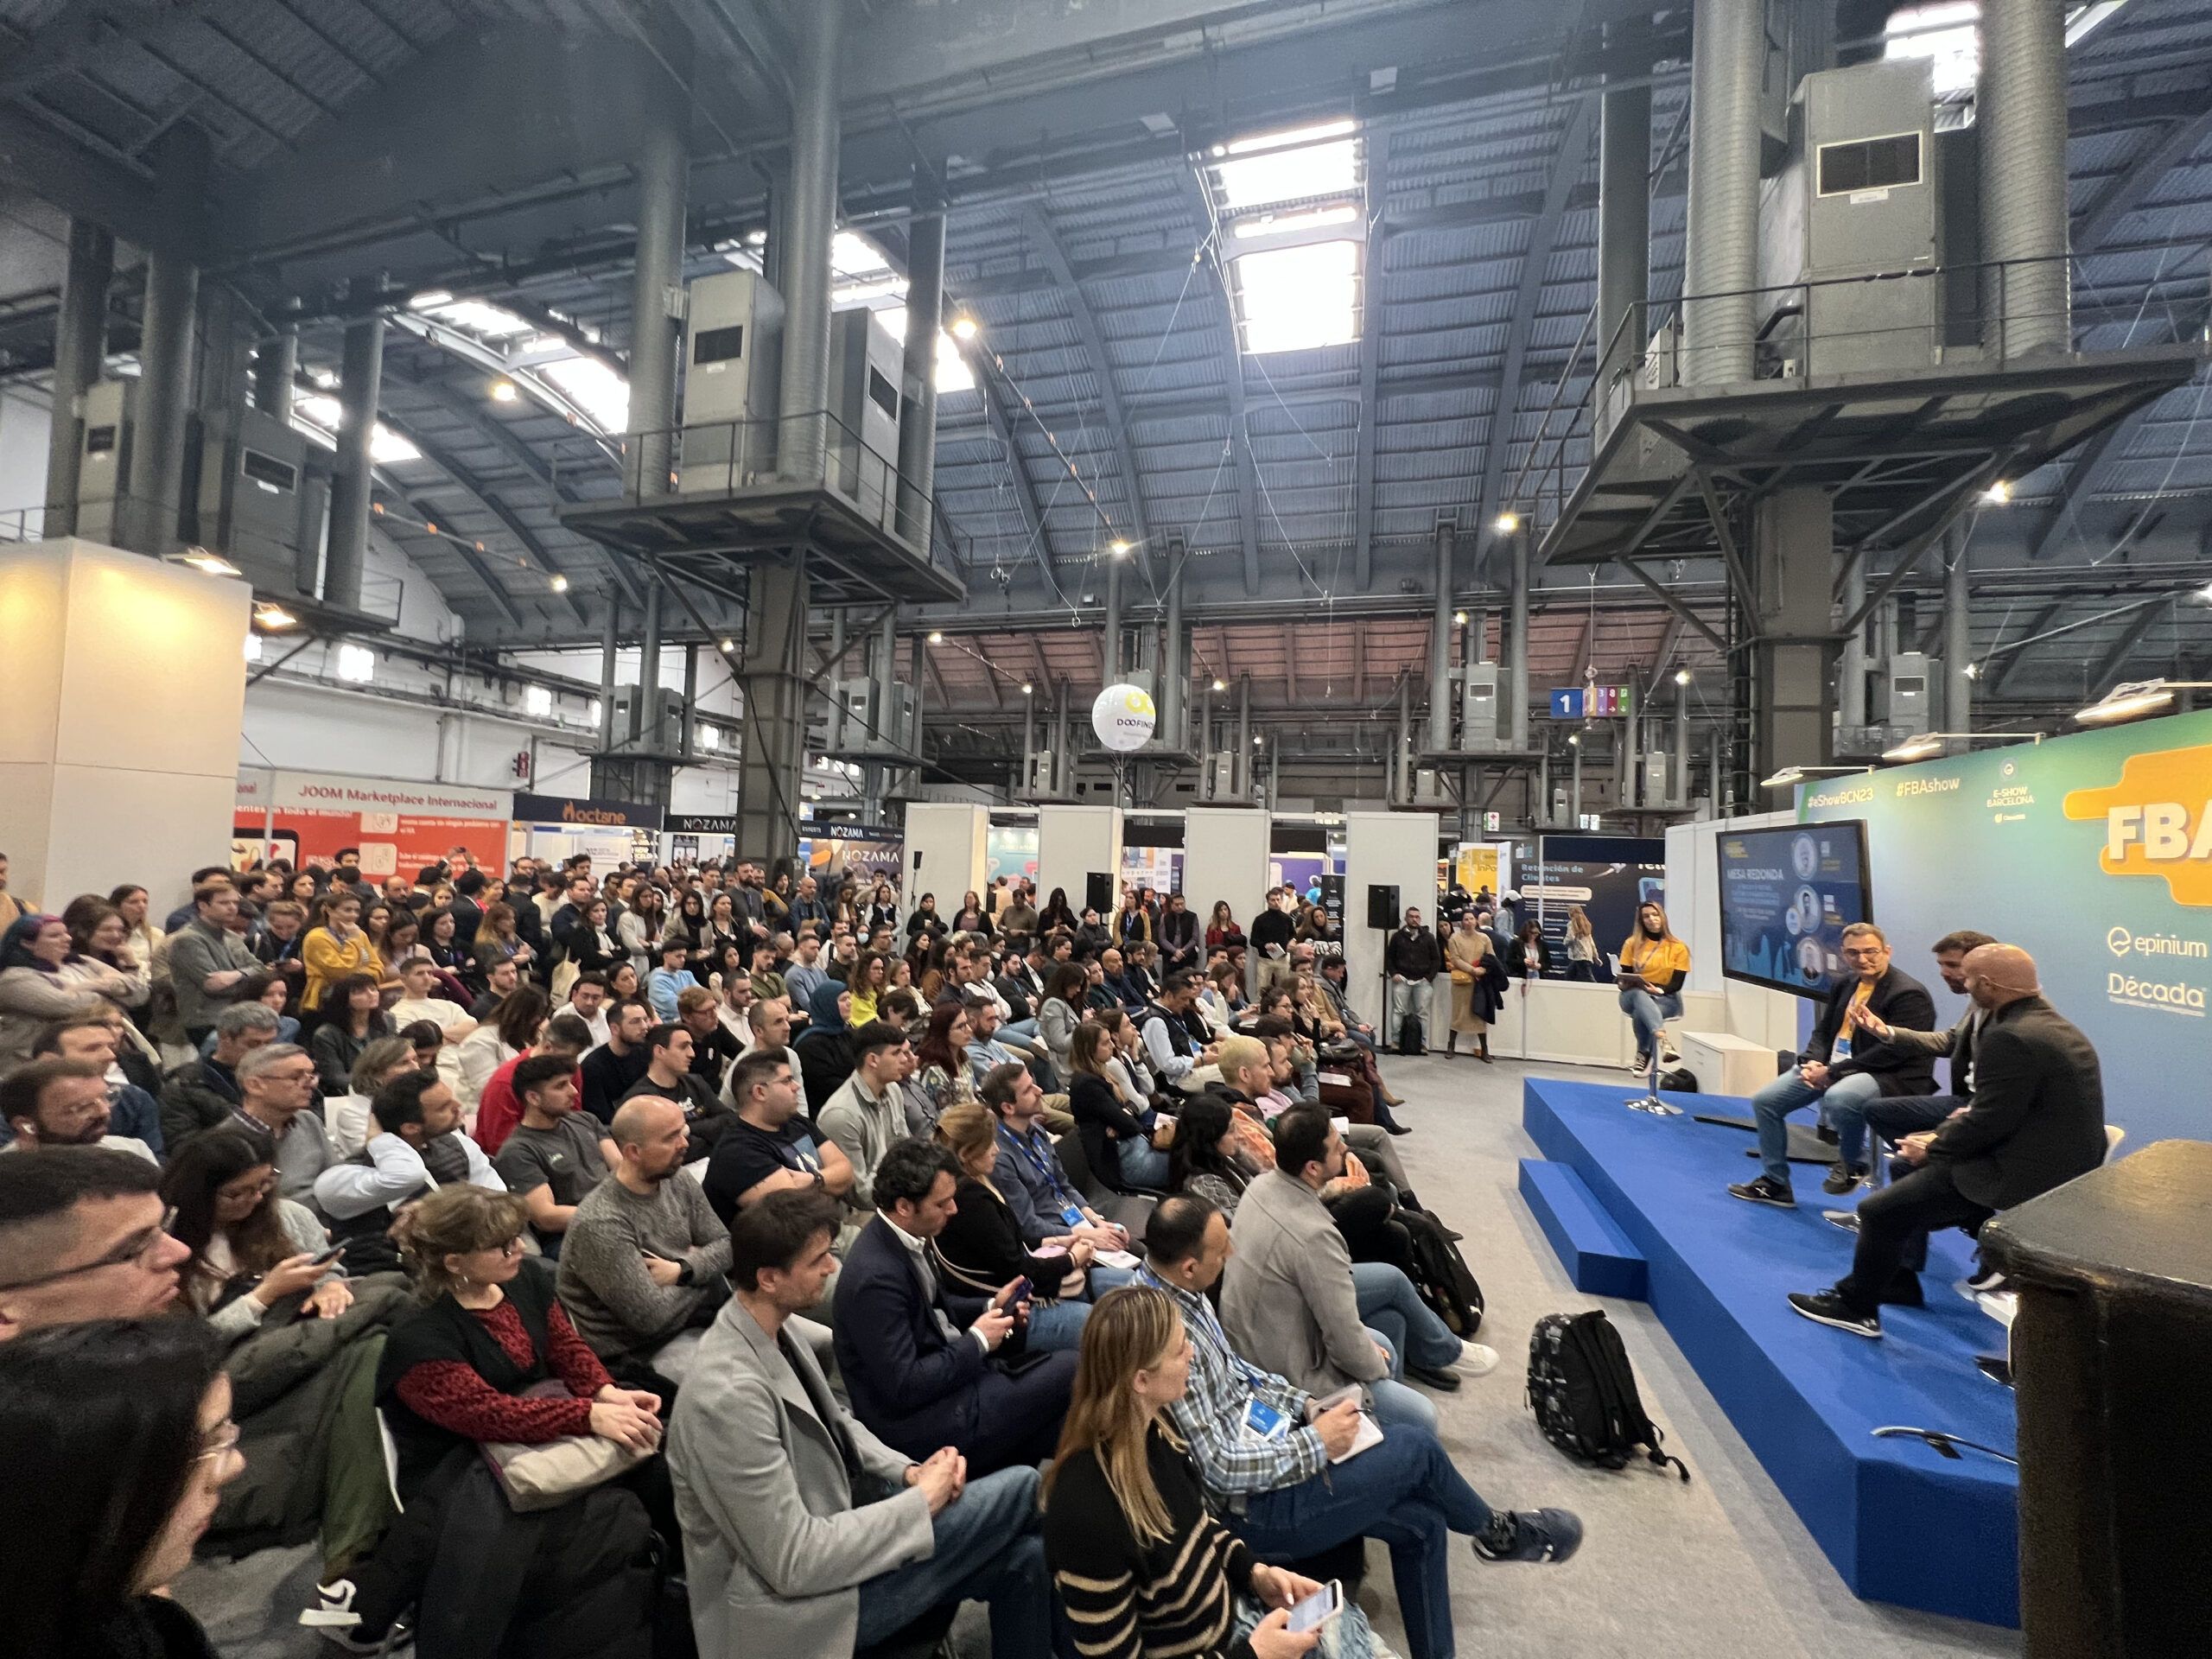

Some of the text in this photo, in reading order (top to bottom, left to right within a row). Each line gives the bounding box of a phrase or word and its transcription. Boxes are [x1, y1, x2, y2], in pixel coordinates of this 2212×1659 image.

[1560, 695, 1570, 713] 1
[1896, 778, 1961, 798] #FBAshow
[1993, 786, 2028, 798] E-SHOW
[298, 785, 498, 810] JOOM Marketplace Internacional
[1808, 787, 1874, 809] #eShowBCN23
[1986, 795, 2035, 808] BARCELONA
[234, 804, 266, 814] entes
[575, 807, 627, 825] octane
[830, 825, 864, 838] NOZAMA
[842, 849, 899, 863] NOZAMA
[1521, 864, 1584, 874] Retnción de
[1727, 868, 1784, 880] MESA REDONDA
[1521, 873, 1560, 882] Clietes
[2134, 933, 2208, 957] epinium
[2107, 972, 2206, 1008] Década
